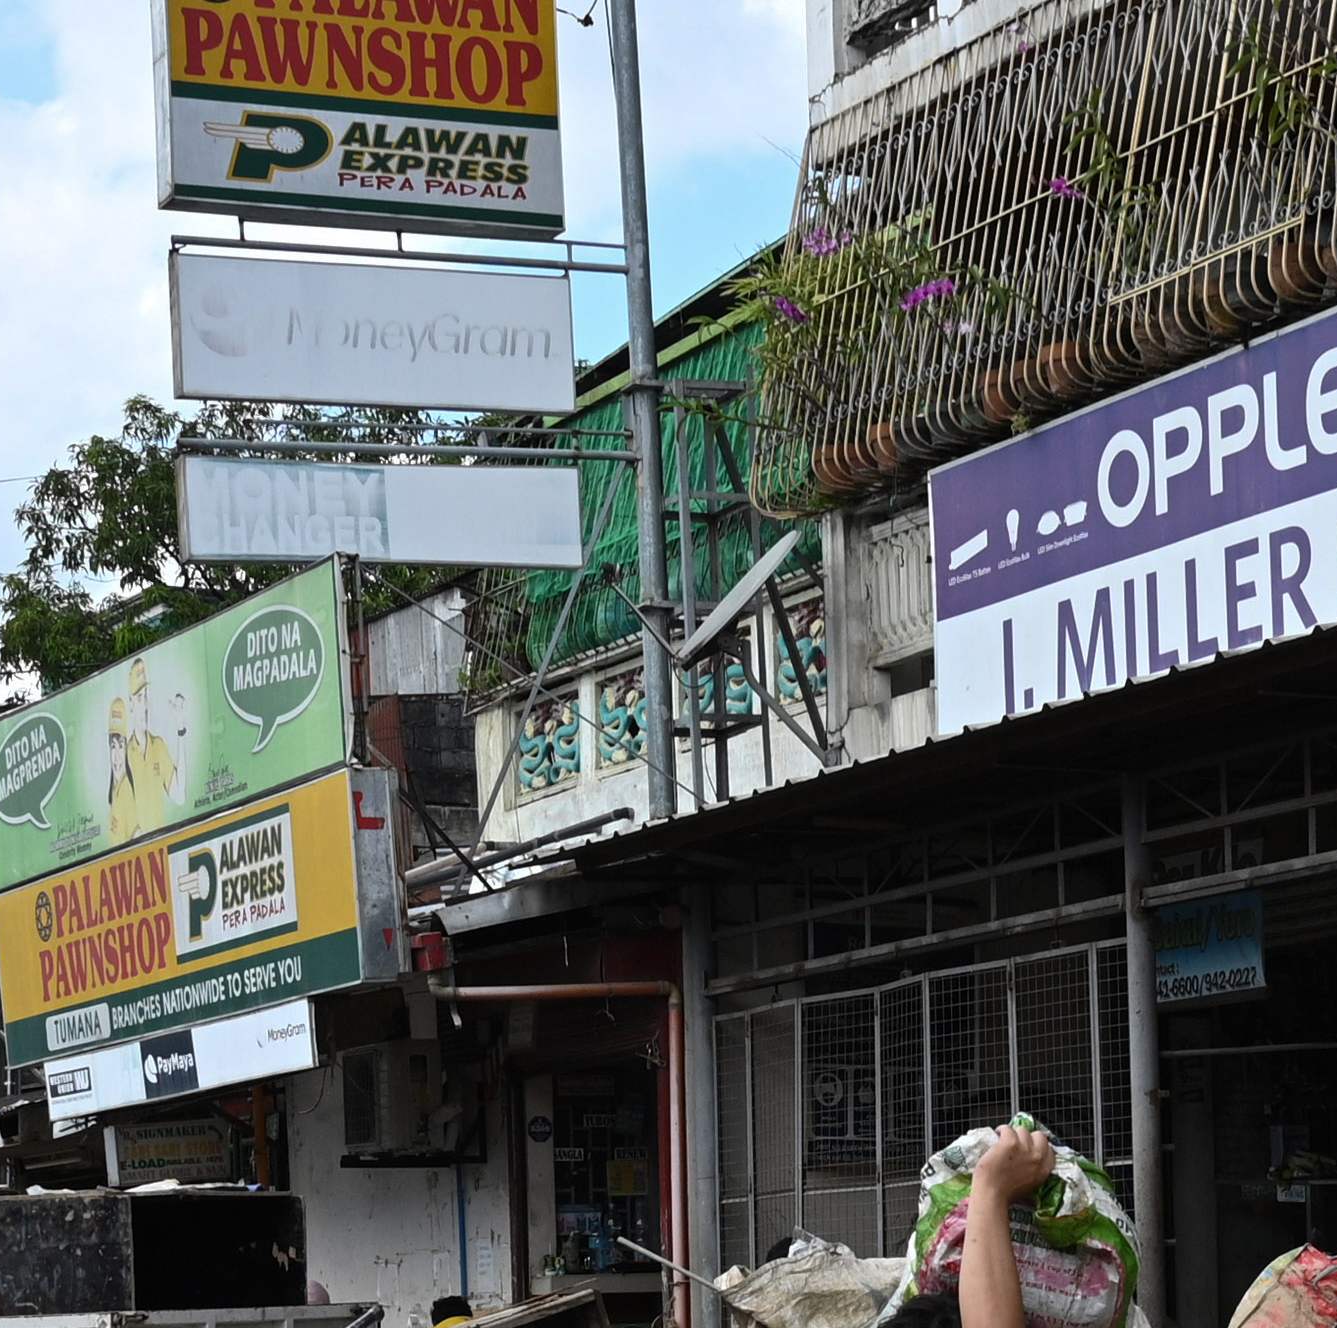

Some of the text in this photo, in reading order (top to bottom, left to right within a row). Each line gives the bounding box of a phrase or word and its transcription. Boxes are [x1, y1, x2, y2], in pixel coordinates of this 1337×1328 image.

[182, 8, 543, 107] PAWNSHOP
[338, 172, 528, 201] PERA PADALA
[340, 150, 530, 186] EXPRESS
[1055, 525, 1317, 700] MILLER
[245, 618, 302, 658] DITO NA
[232, 646, 317, 691] MAGPADALA
[4, 724, 47, 764] DITO NA
[53, 847, 167, 938] PALAWAN
[221, 862, 286, 911] EXPRESS
[222, 897, 287, 931] PERA PADALA
[39, 911, 172, 1003] PAWNSHOP
[53, 954, 303, 1045] TUMANA BRANCHES NATIONWIDE TO SERVE YOU
[267, 1023, 307, 1043] MoneyGram
[156, 1051, 195, 1075] PayMaya
